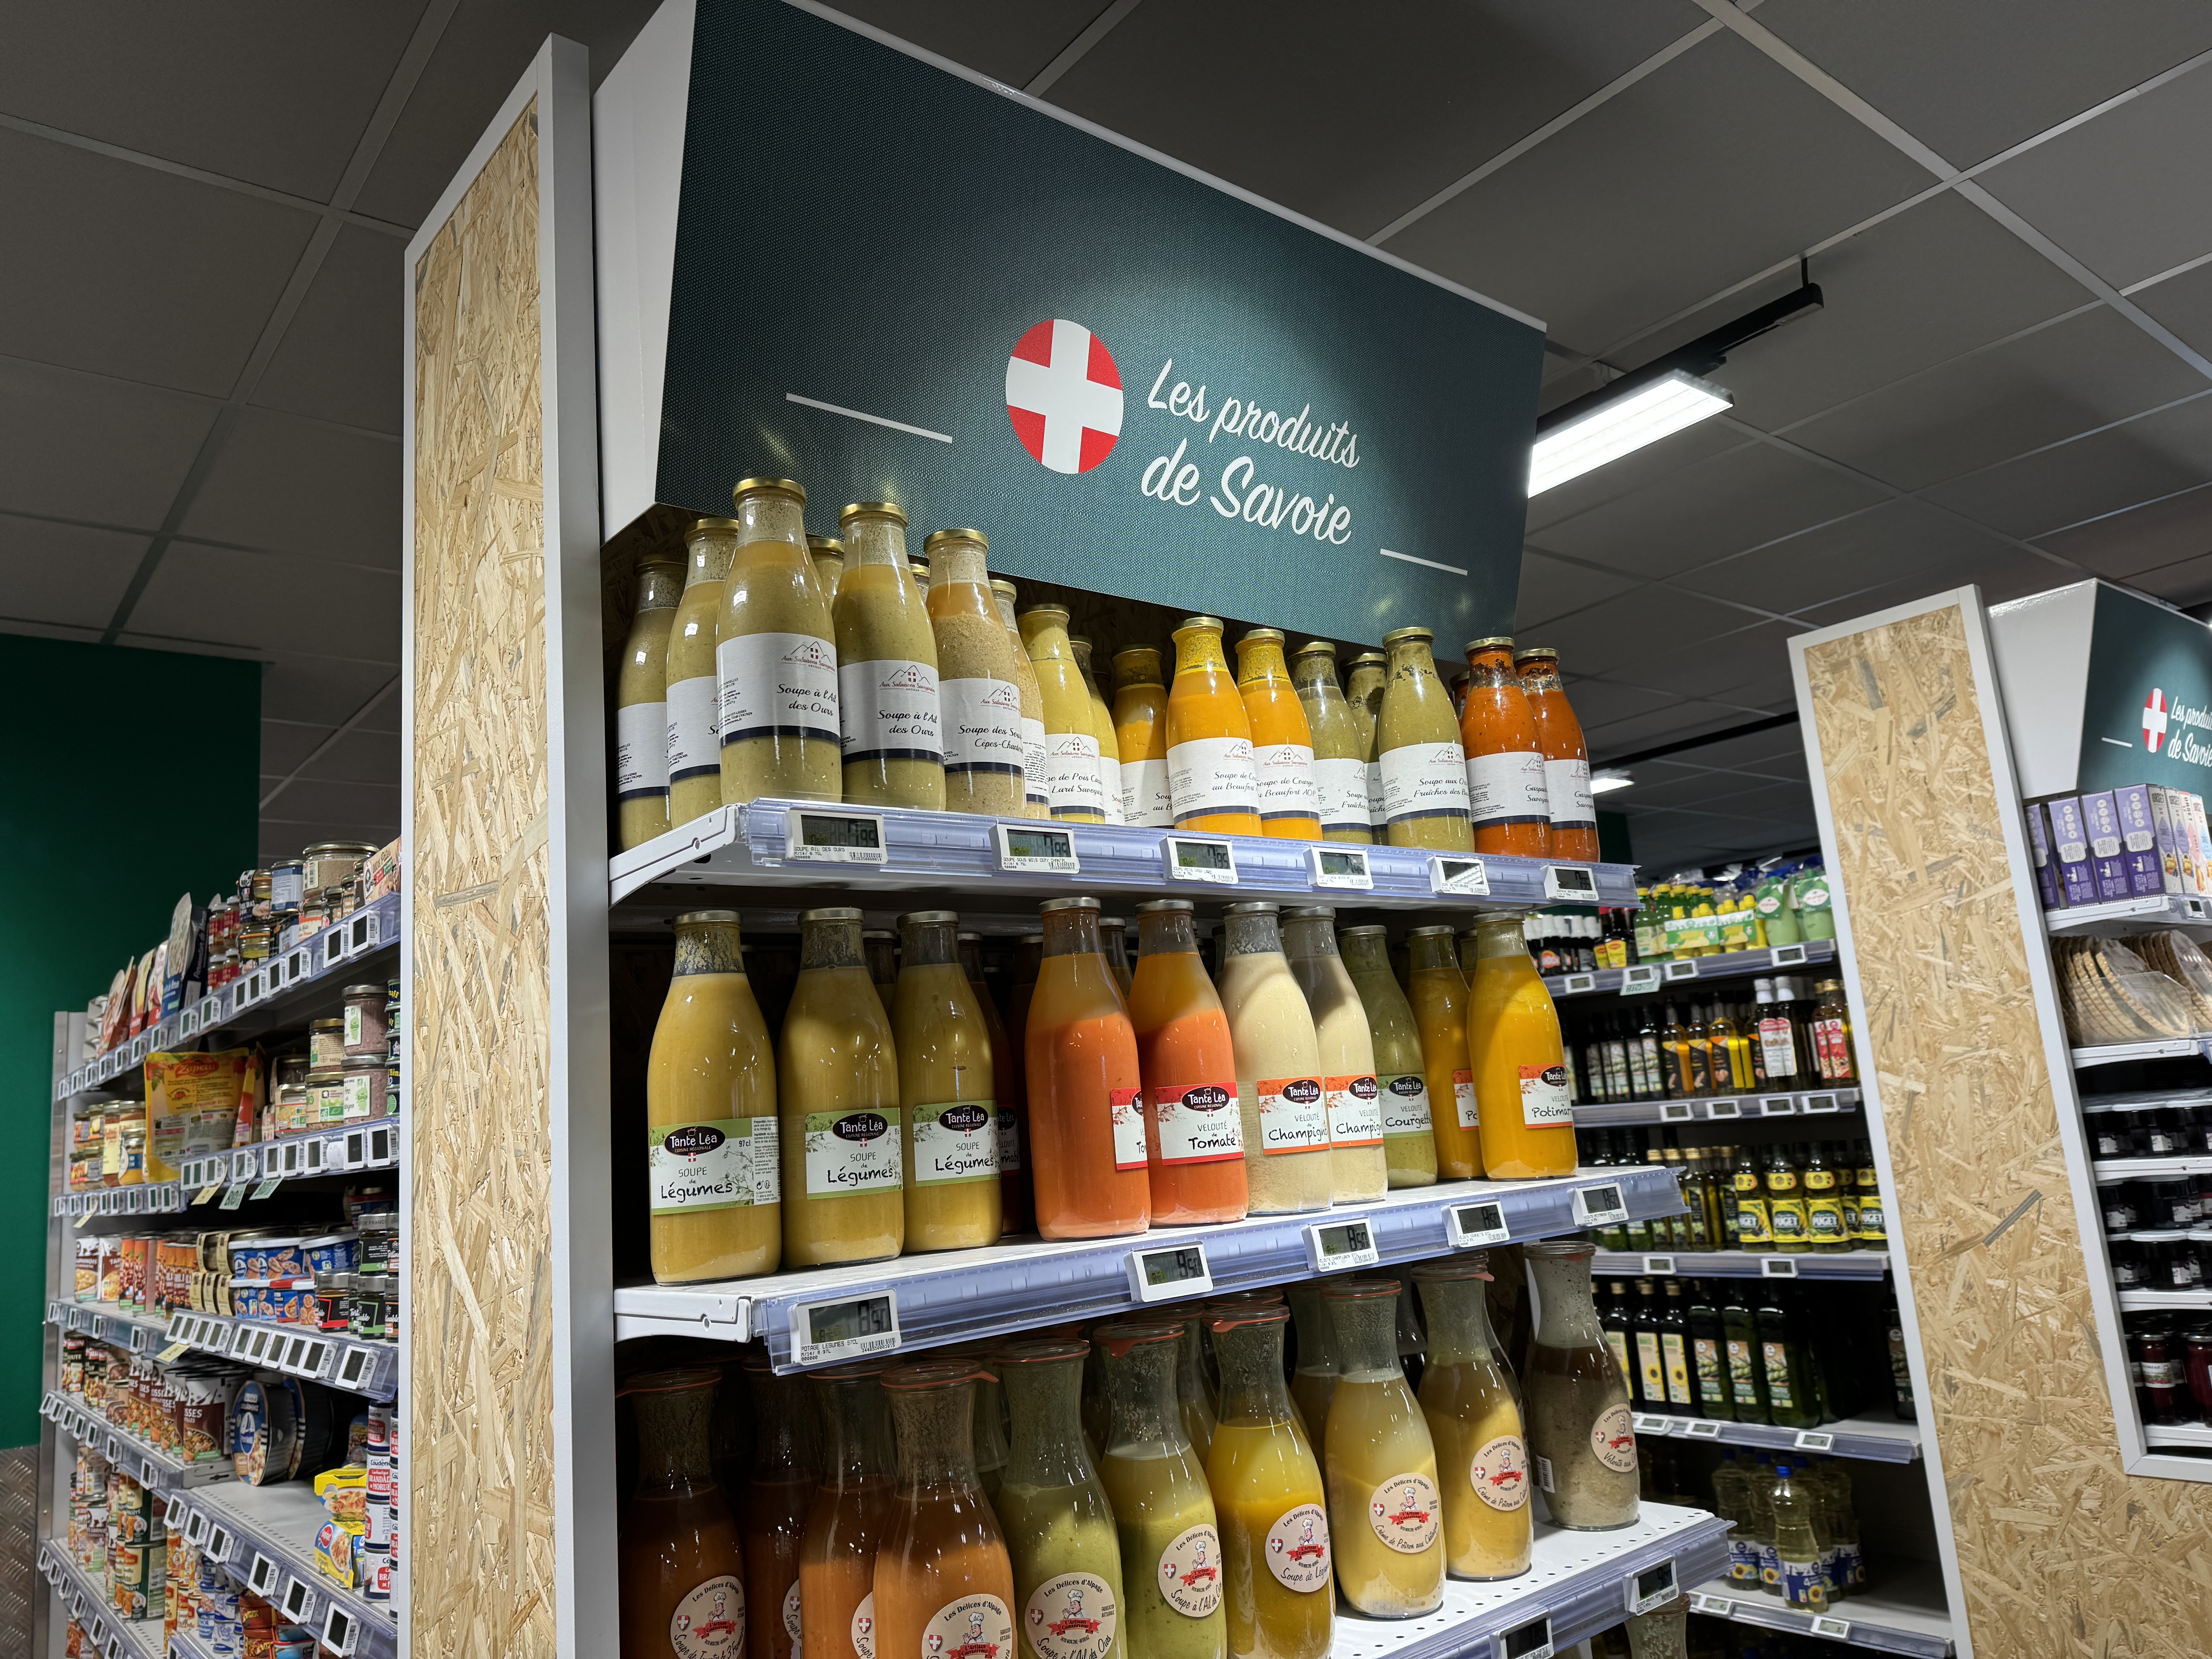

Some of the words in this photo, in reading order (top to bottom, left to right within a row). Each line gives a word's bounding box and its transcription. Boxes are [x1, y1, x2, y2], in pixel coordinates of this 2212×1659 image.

[1147, 358, 1209, 422] Les
[1209, 395, 1360, 468] produits
[1140, 439, 1200, 507] de
[1210, 456, 1352, 545] Savoie
[795, 656, 817, 665] Salaisons
[776, 684, 811, 696] Soupe
[814, 688, 820, 696] à
[789, 701, 807, 710] des
[811, 702, 833, 716] Ours
[878, 710, 911, 720] Soupe
[2171, 696, 2185, 722] Les
[890, 725, 908, 734] des
[911, 725, 934, 737] Ours
[958, 725, 989, 734] Soupe
[993, 726, 1007, 734] des
[2168, 729, 2181, 759] de
[1072, 773, 1089, 781] Pois
[1214, 772, 1238, 781] Soupe
[1293, 777, 1313, 787] Courge
[1419, 778, 1443, 787] Soupe
[1265, 789, 1300, 798] Beaufort
[1414, 790, 1448, 798] Fraîches
[1546, 1072, 1560, 1081] Tante
[1288, 1087, 1309, 1097] Tante
[1310, 1086, 1318, 1096] Léa
[1354, 1084, 1370, 1093] Tante
[1188, 1094, 1212, 1104] Tante
[1214, 1092, 1226, 1102] Léa
[946, 1113, 970, 1124] Tante
[972, 1111, 984, 1121] Léa
[1295, 1113, 1319, 1122] VELOUTÉ
[840, 1123, 866, 1133] Tante
[869, 1121, 883, 1131] Léa
[1197, 1120, 1227, 1132] VELOUTÉ
[670, 1135, 696, 1147] Tante
[699, 1134, 717, 1144] Léa
[956, 1142, 980, 1151] SOUPE
[1188, 1134, 1235, 1150] Tomate
[850, 1152, 876, 1161] SOUPE
[936, 1155, 993, 1174] Légumes
[678, 1167, 707, 1177] SOUPE
[828, 1167, 893, 1186] Légumes
[661, 1182, 732, 1203] Légumes
[1812, 1213, 1838, 1226] PUGET
[1492, 1442, 1507, 1450] Délices
[1384, 1485, 1393, 1494] Les
[1394, 1479, 1413, 1488] Délices
[1478, 1487, 1490, 1501] Crème
[1498, 1498, 1513, 1508] Potiron
[1283, 1518, 1293, 1527] Les
[1293, 1510, 1310, 1520] Délices
[1176, 1541, 1185, 1551] Les
[1186, 1532, 1203, 1542] Délices
[1375, 1525, 1389, 1540] Crème
[1397, 1539, 1414, 1549] Potiron
[1280, 1567, 1303, 1585] Soupe
[1306, 1571, 1313, 1581] de
[692, 1592, 703, 1602] Les
[704, 1583, 724, 1593] Délices
[1044, 1587, 1055, 1597] Les
[1056, 1580, 1079, 1589] Délices
[1081, 1579, 1103, 1593] d'Alpage
[1171, 1589, 1190, 1611] Soupe
[1192, 1601, 1198, 1611] à
[1199, 1594, 1212, 1611] l'Ail
[944, 1611, 956, 1621] Les
[957, 1602, 981, 1613] Délices
[982, 1601, 1001, 1616] d'Alpage
[674, 1635, 690, 1655] Soupe
[727, 1645, 732, 1658] 3
[1037, 1637, 1058, 1659] Soupe
[1098, 1635, 1111, 1652] Ours
